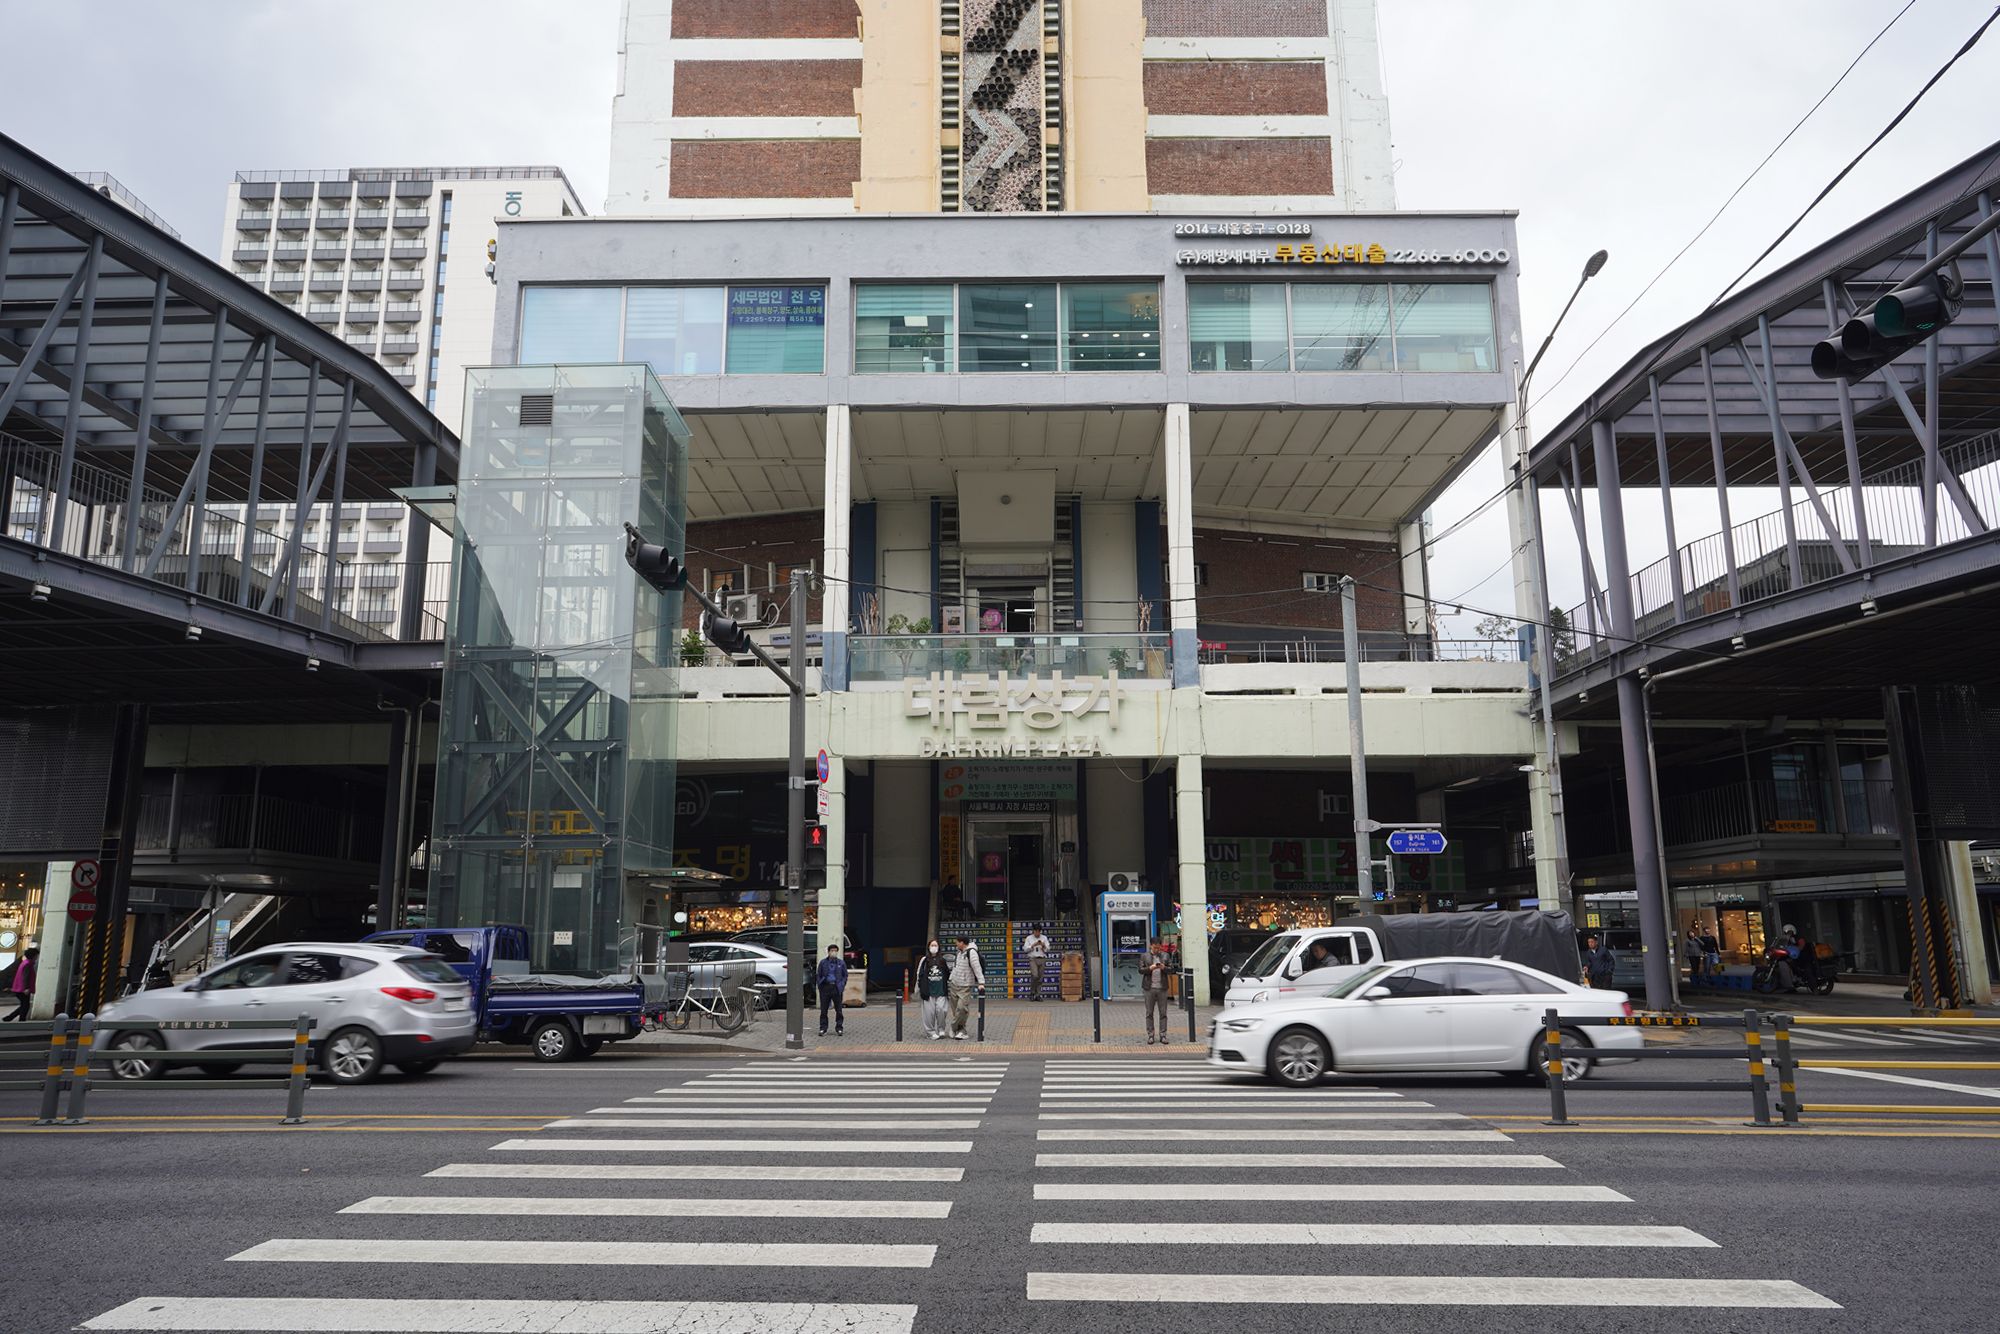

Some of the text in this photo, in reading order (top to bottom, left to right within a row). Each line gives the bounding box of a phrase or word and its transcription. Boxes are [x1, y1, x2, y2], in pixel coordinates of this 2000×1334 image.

[1275, 242, 1387, 264] 부동산대출
[1393, 249, 1511, 264] 2266-6000
[732, 290, 782, 304] 세무법인
[903, 669, 1127, 730] 대림상가
[1025, 736, 1106, 758] PLAZA
[1408, 833, 1425, 841] 을지로
[1207, 844, 1238, 861] UN
[1208, 868, 1240, 881] rtec
